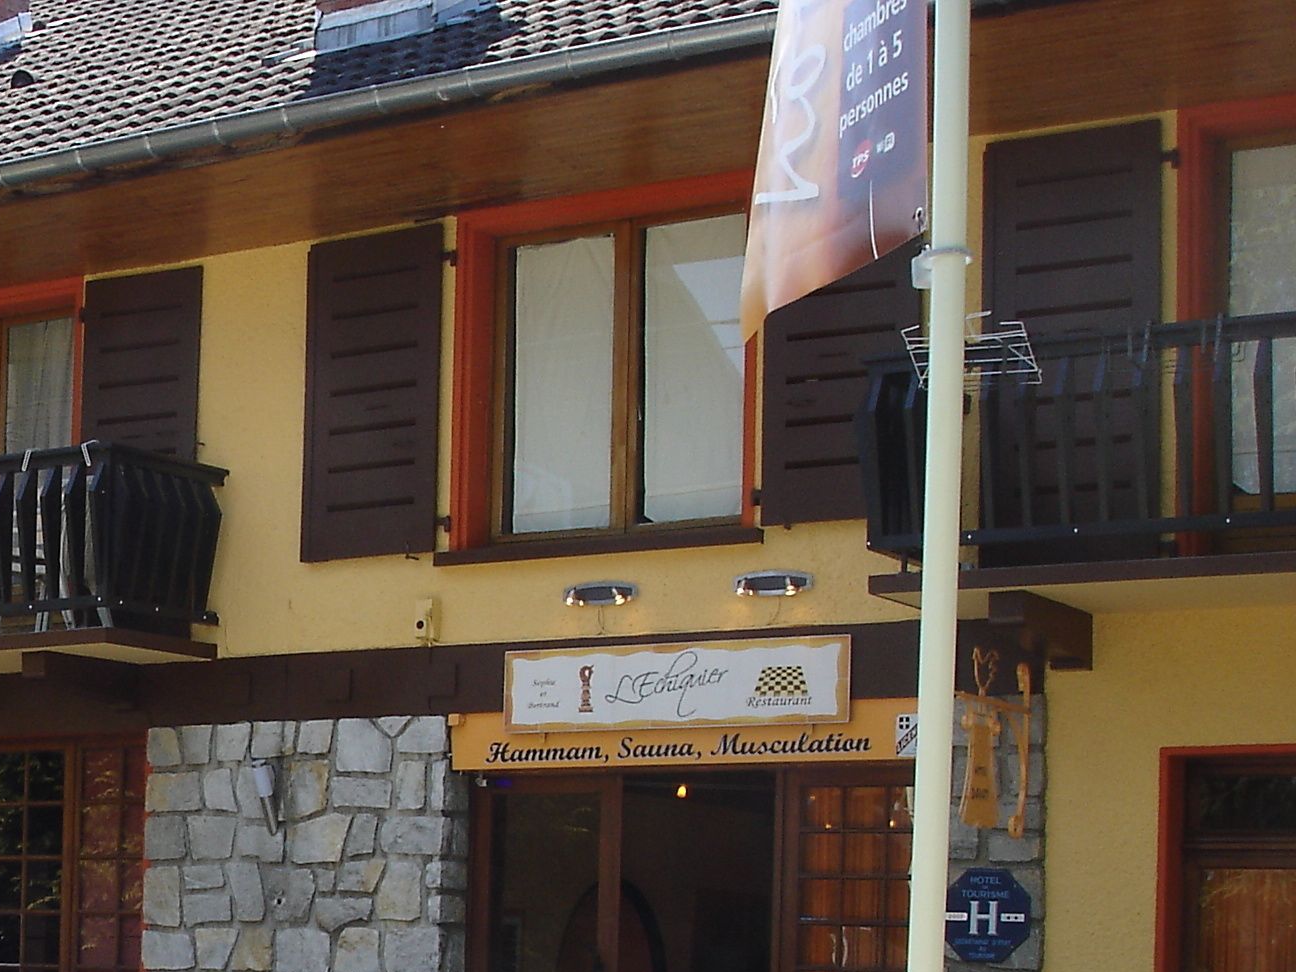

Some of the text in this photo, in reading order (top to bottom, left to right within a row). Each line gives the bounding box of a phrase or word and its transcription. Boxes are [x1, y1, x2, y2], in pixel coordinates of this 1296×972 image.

[843, 0, 907, 51] chambres
[846, 30, 903, 91] de 1 à 5
[839, 71, 909, 138] personnes
[746, 696, 812, 708] Restaurant
[711, 733, 871, 755] Musculation
